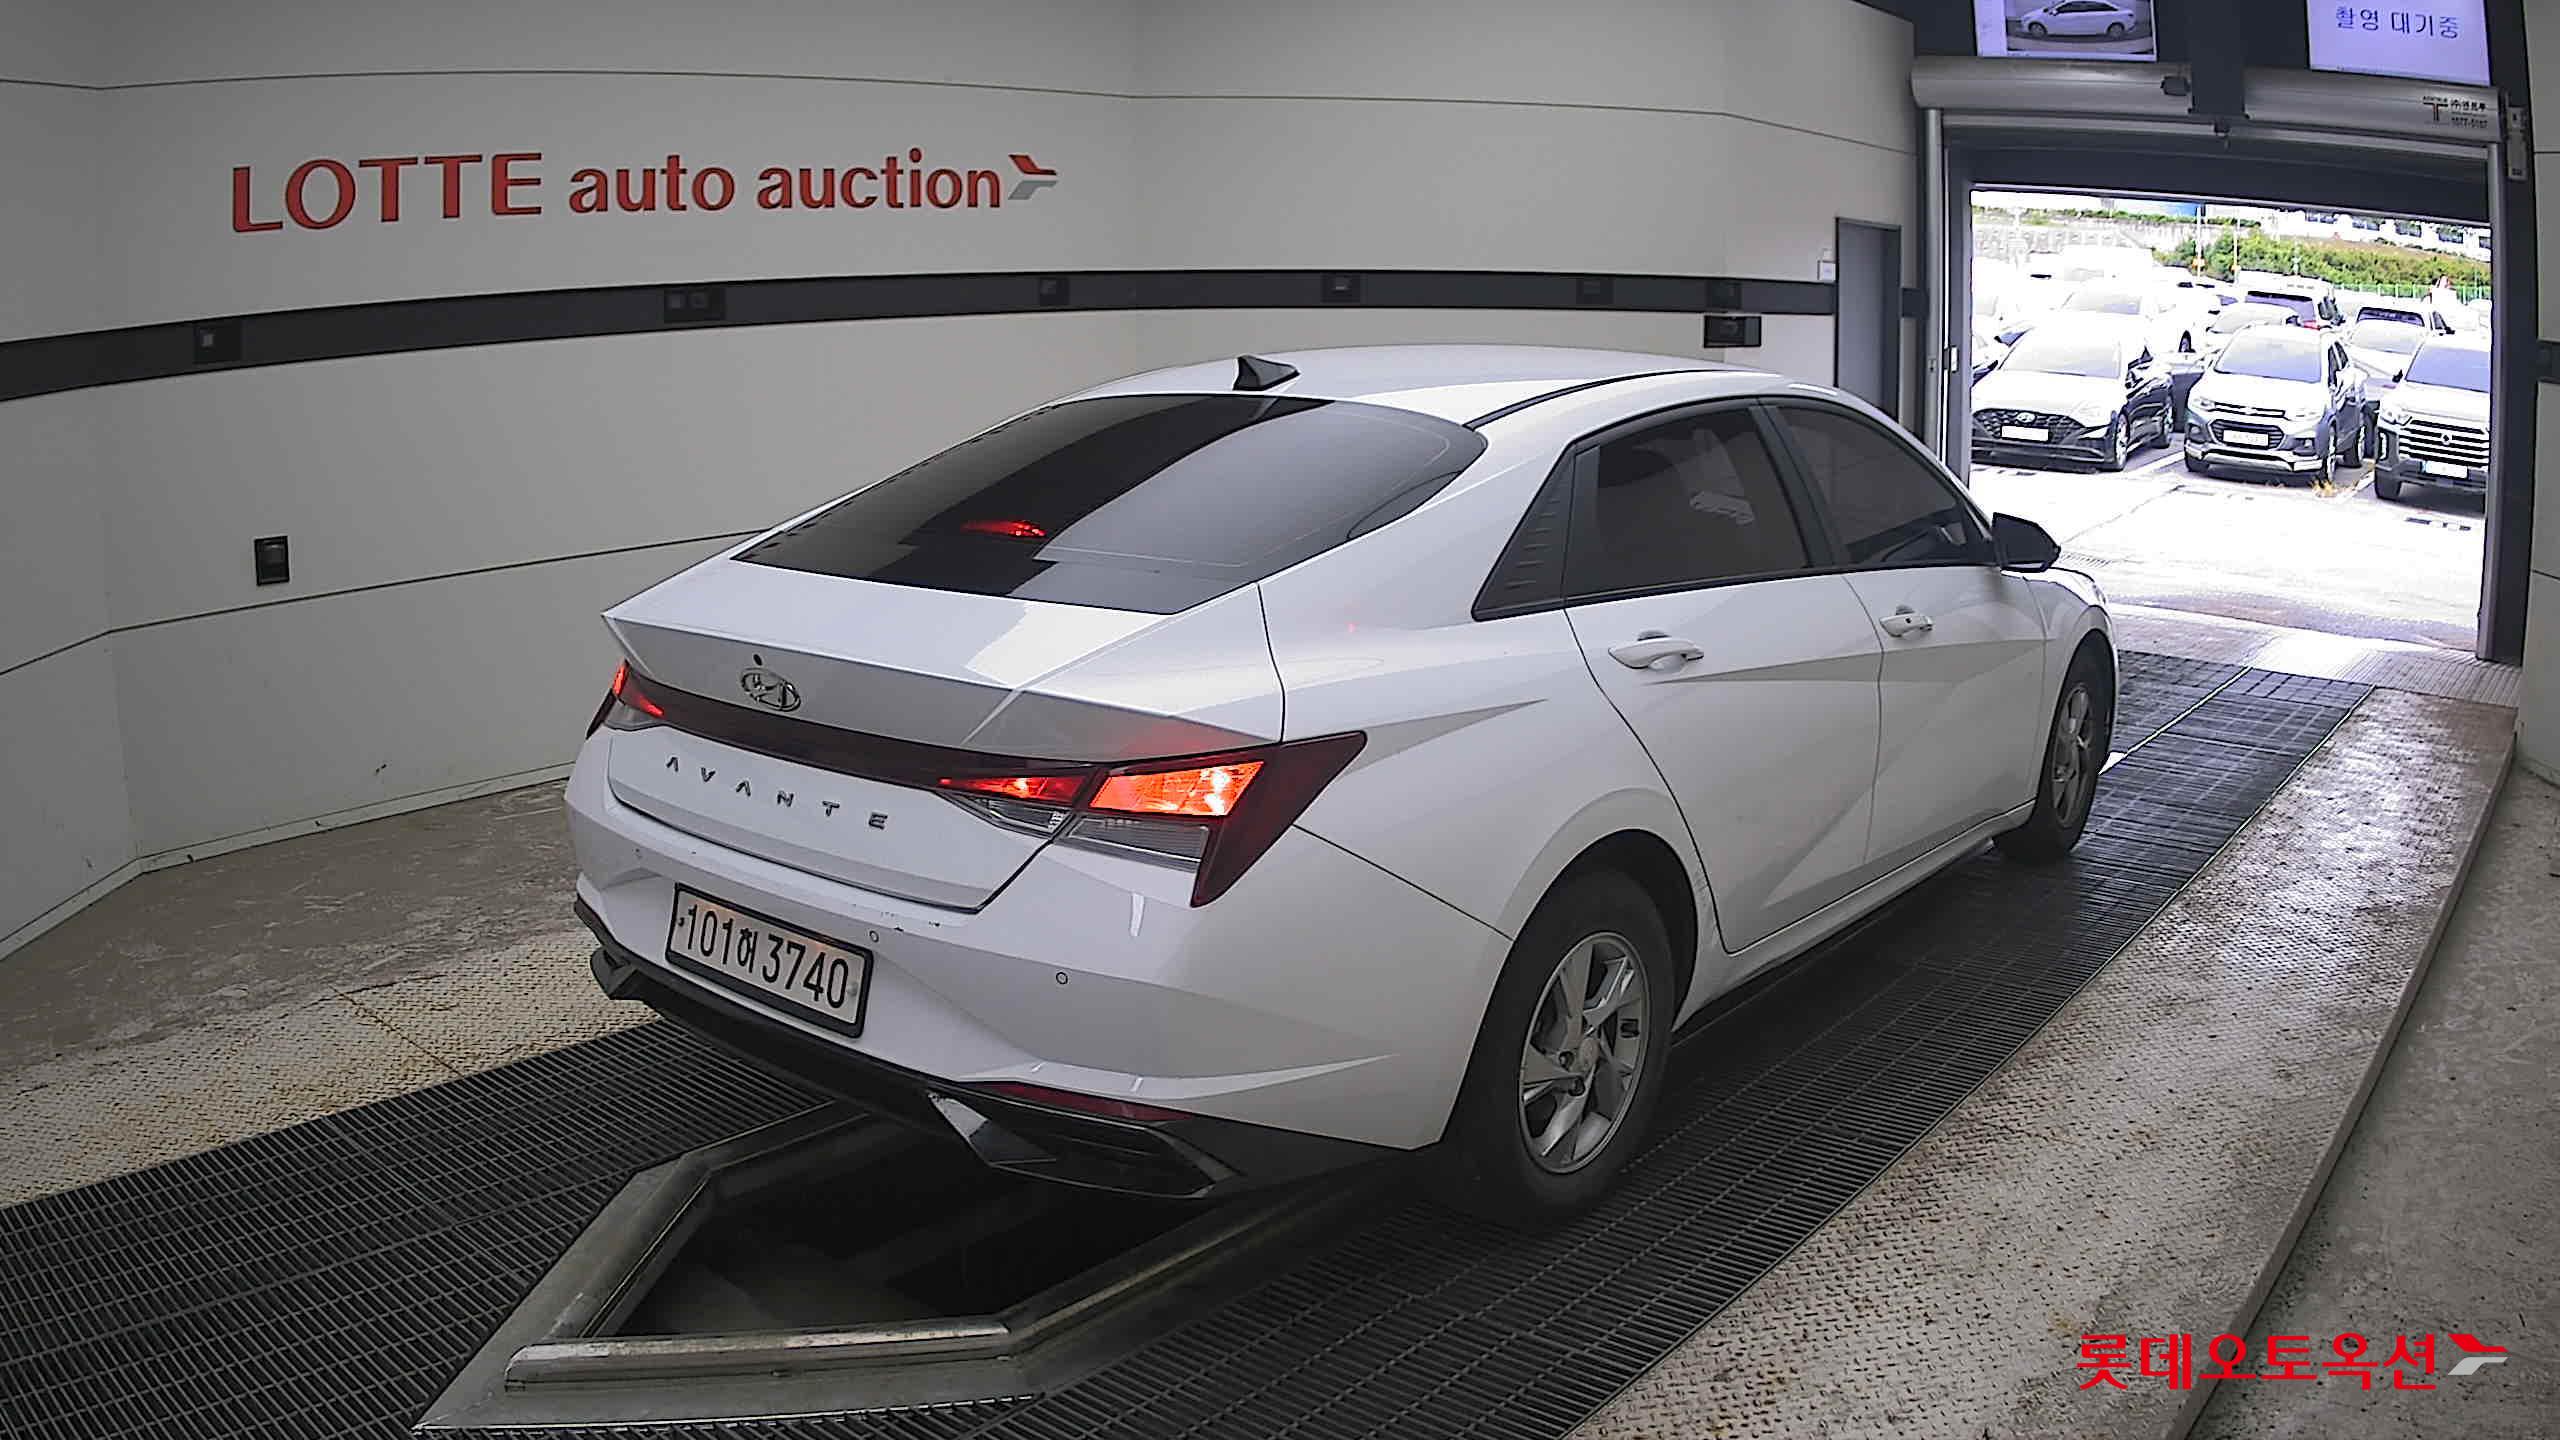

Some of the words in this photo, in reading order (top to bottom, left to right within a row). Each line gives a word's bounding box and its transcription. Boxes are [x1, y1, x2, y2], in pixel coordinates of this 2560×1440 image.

[2336, 6, 2380, 32] 촬영
[2390, 11, 2460, 40] 대기중
[232, 151, 543, 234] LOTTE
[568, 153, 736, 214] auto
[756, 146, 1002, 210] auction
[666, 755, 889, 830] AVANTE
